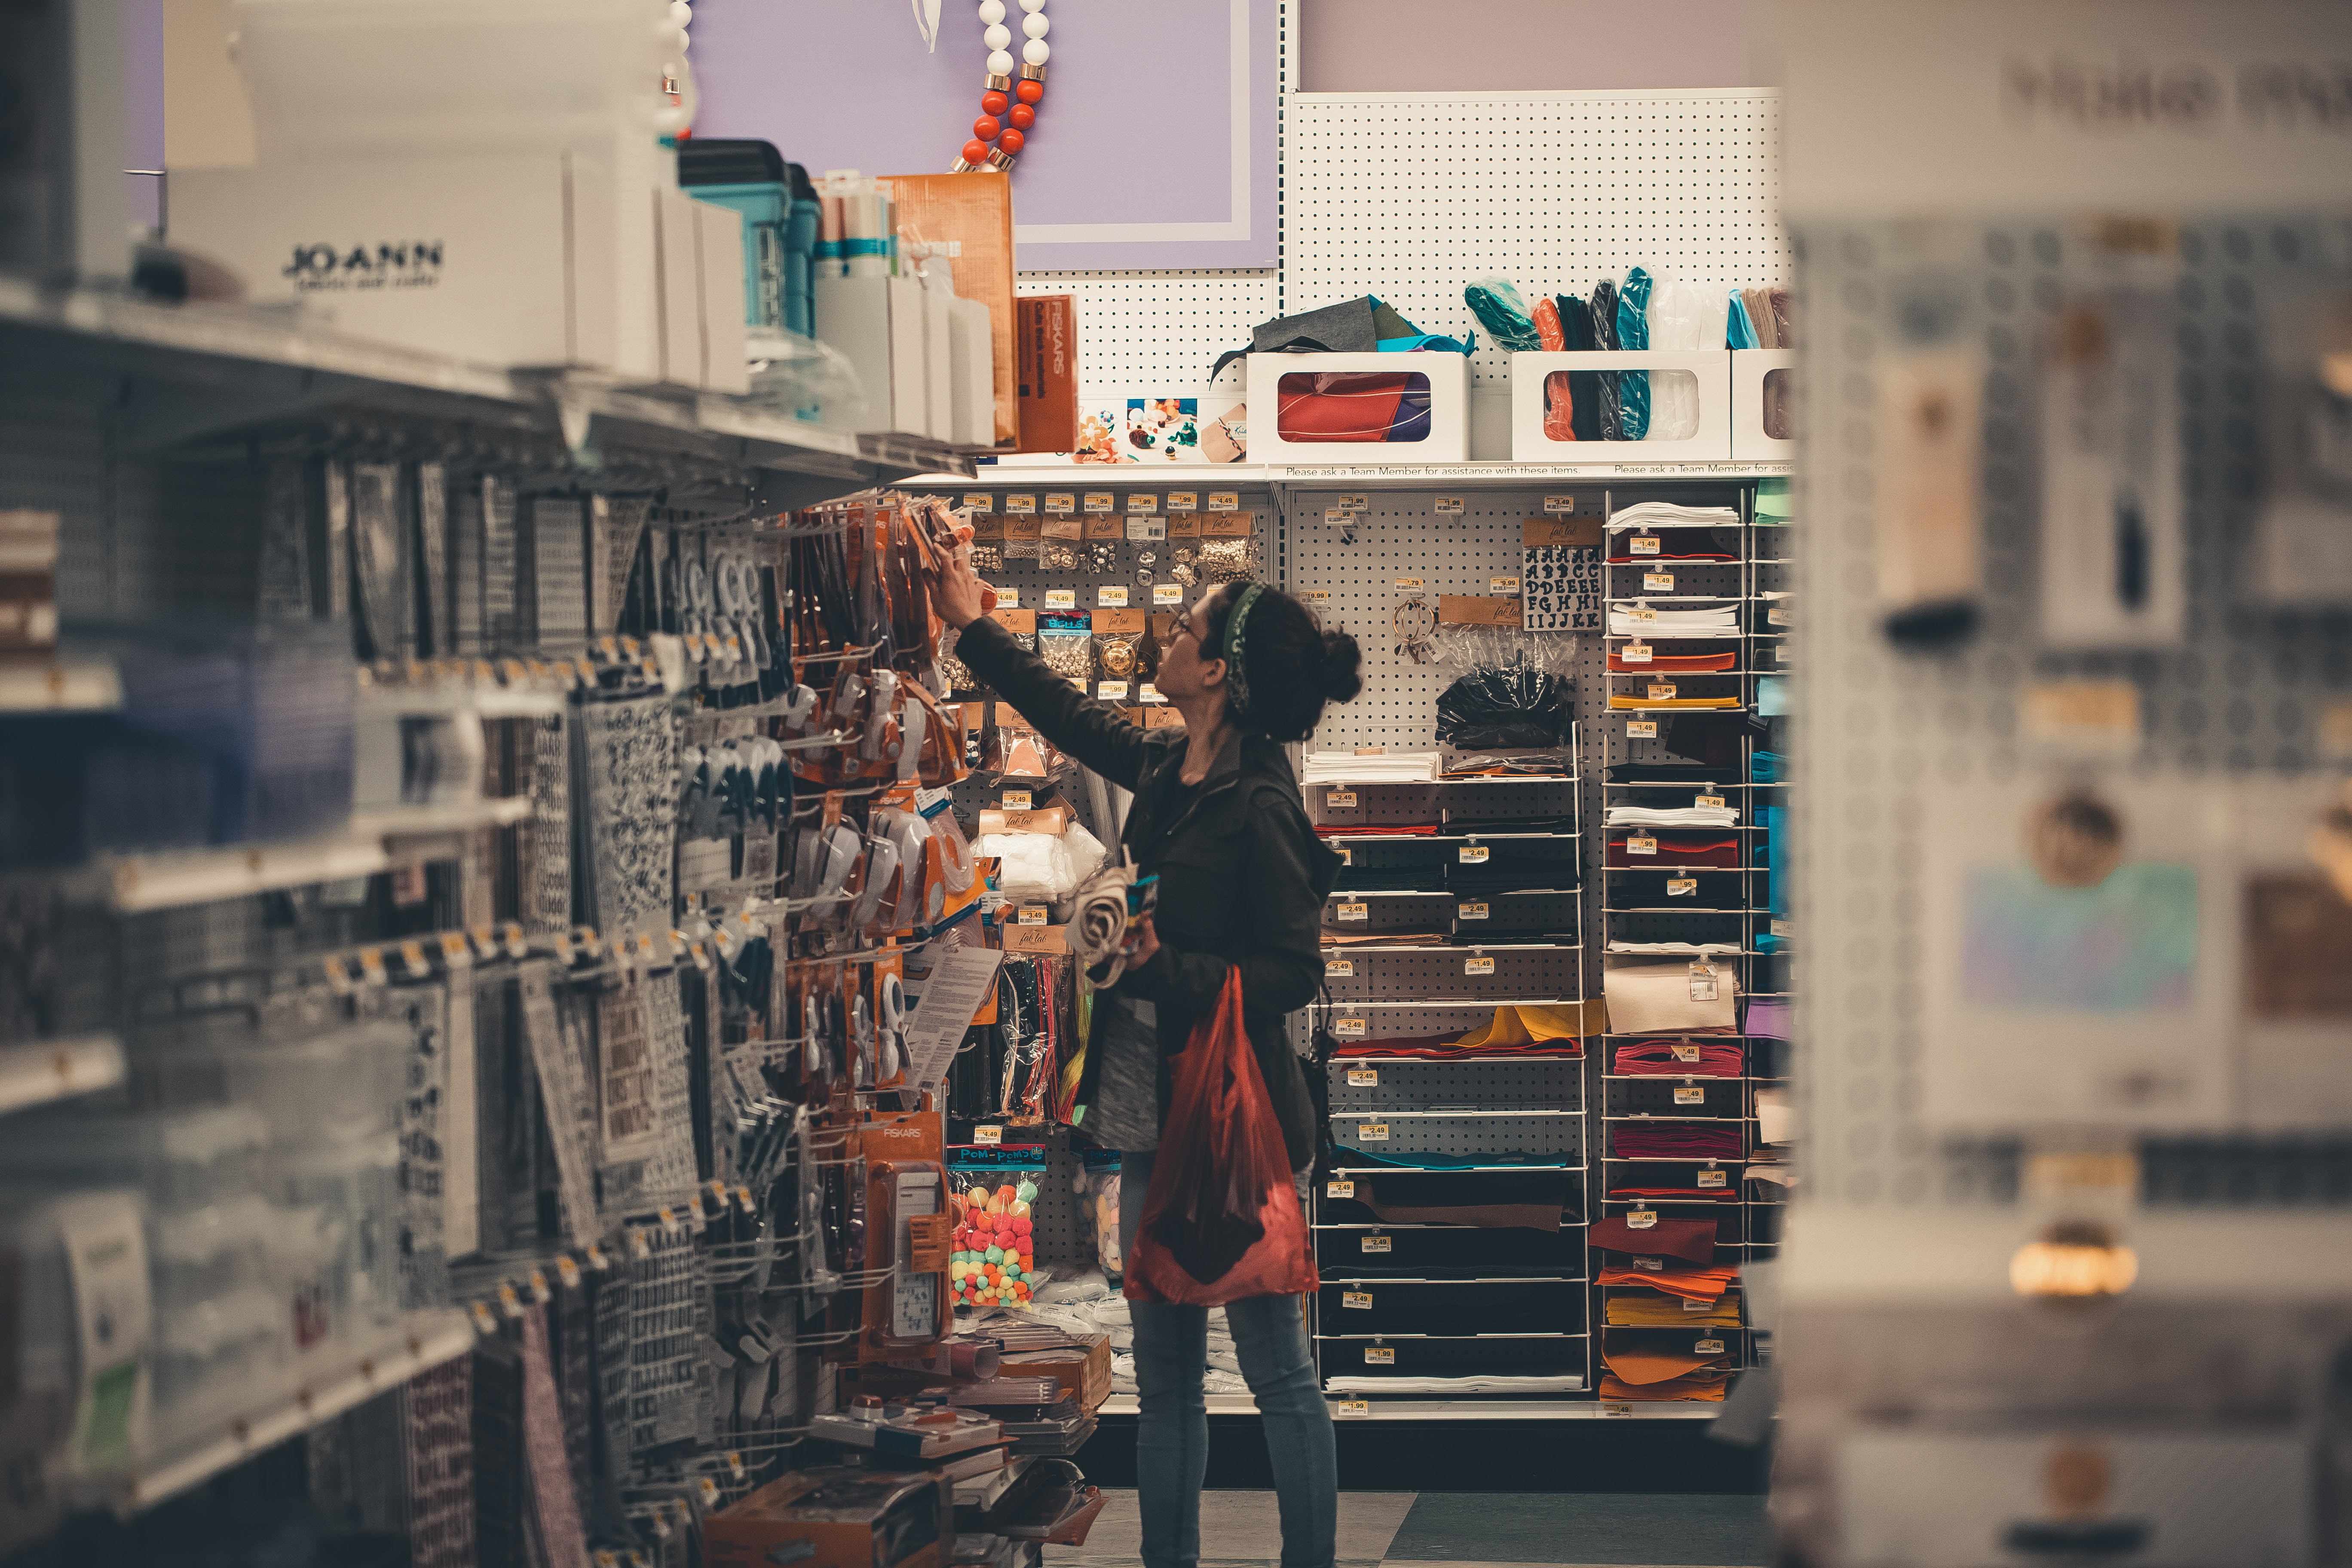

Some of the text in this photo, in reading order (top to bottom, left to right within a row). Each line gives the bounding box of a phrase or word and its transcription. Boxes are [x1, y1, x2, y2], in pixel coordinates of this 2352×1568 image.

[1052, 301, 1065, 375] FISKARS
[1286, 467, 1317, 476] Please
[1321, 466, 1337, 476] ask
[1349, 467, 1375, 475] Team
[1379, 466, 1421, 475] Member
[1425, 466, 1438, 475] for
[1442, 466, 1492, 475] assistance
[1495, 466, 1516, 475] with
[1520, 465, 1548, 474] these
[1551, 466, 1580, 474] items.
[1614, 465, 1646, 474] Please
[1649, 464, 1666, 473] ask
[1678, 464, 1704, 473] Team
[1708, 464, 1751, 473] Member
[1754, 463, 1768, 472] for
[1048, 619, 1083, 629] BELLS
[1019, 932, 1047, 946] fab lab
[884, 1129, 921, 1138] FISKARS
